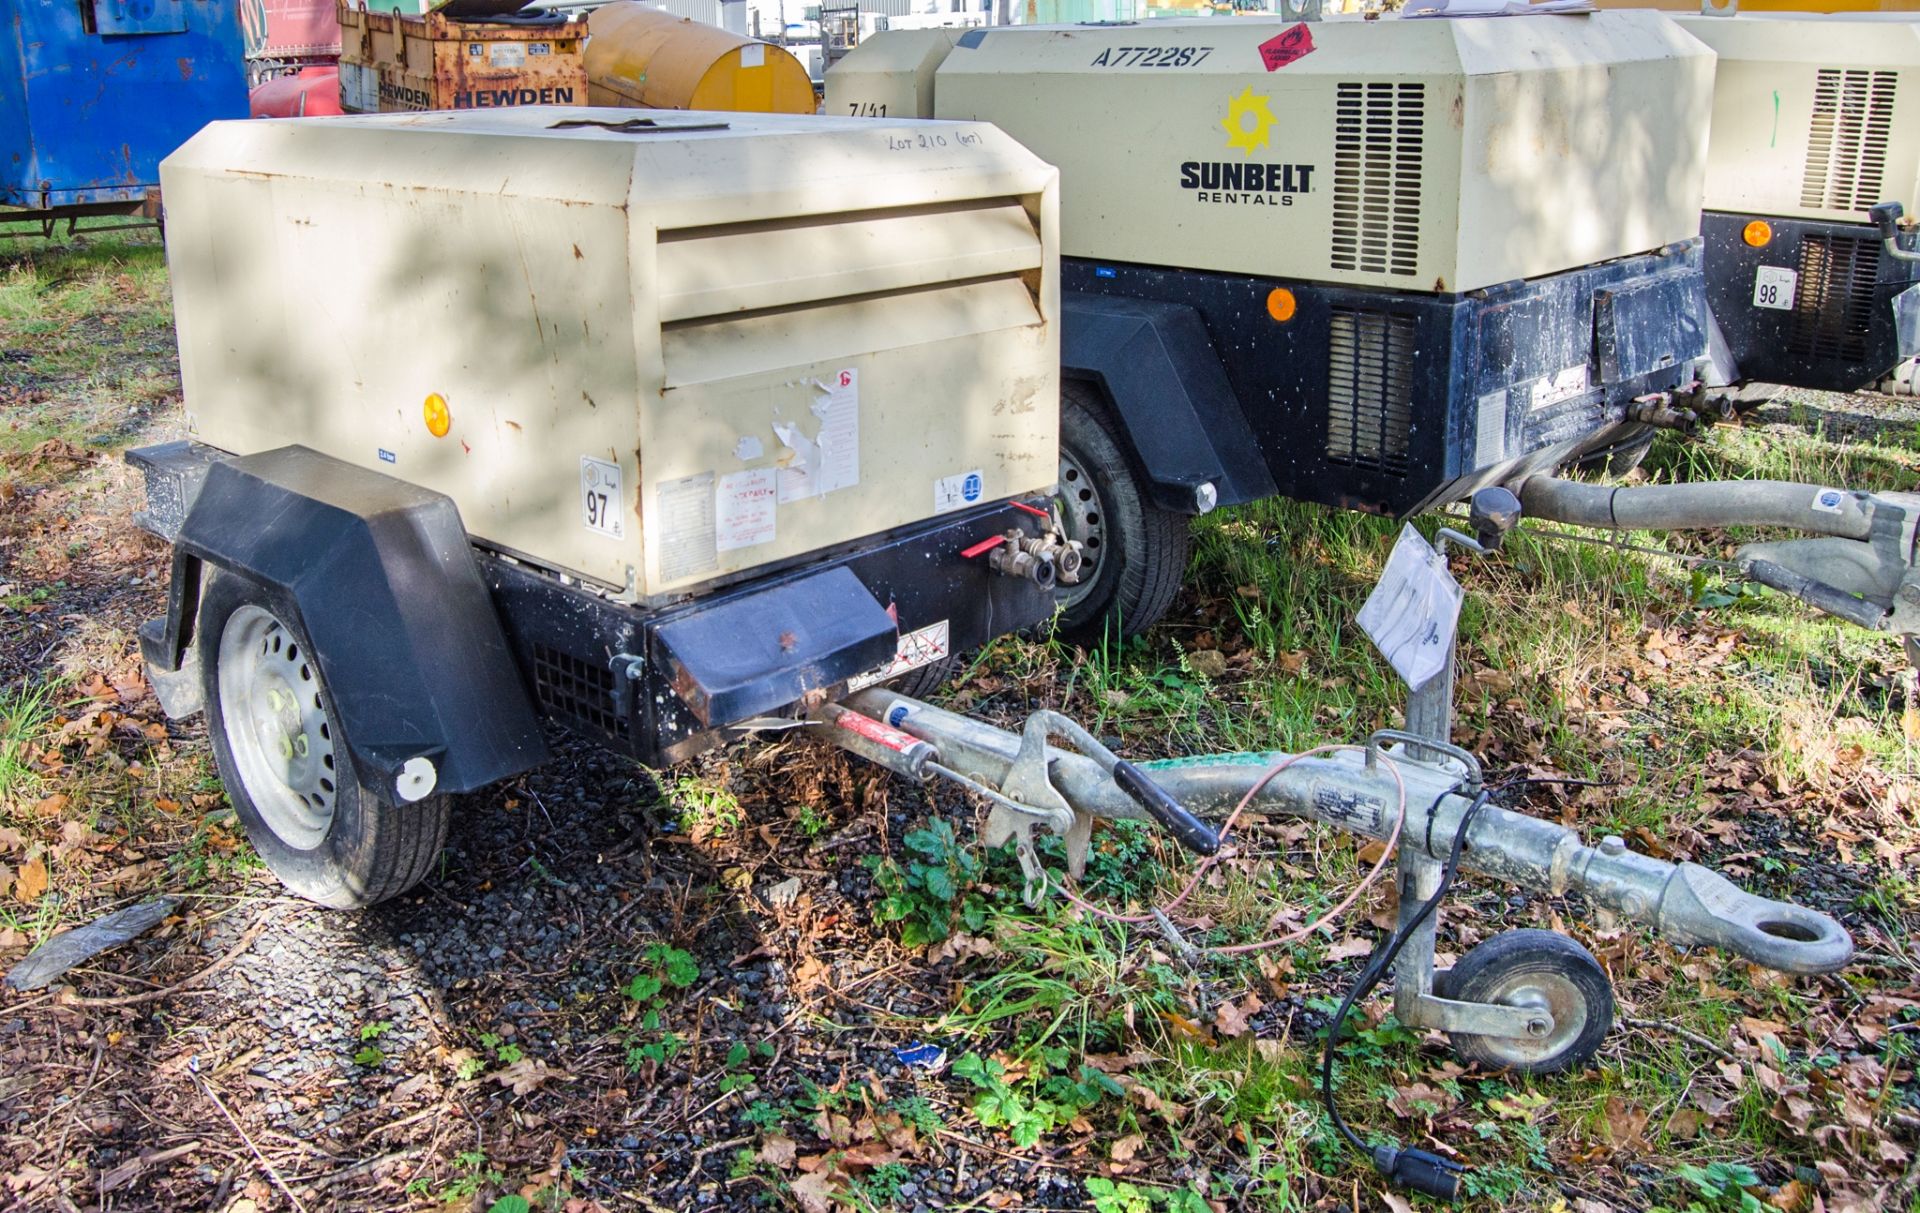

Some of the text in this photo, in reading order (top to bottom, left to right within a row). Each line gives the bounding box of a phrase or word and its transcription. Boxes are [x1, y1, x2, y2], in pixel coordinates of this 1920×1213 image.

[1090, 46, 1215, 68] A772287
[378, 81, 430, 107] HEWDEN
[454, 87, 574, 109] HEWDEN
[919, 134, 947, 149] 210
[1180, 161, 1315, 193] SUNBELT
[1198, 191, 1293, 206] RENTALS
[1759, 284, 1778, 305] 98
[587, 489, 607, 528] 97
